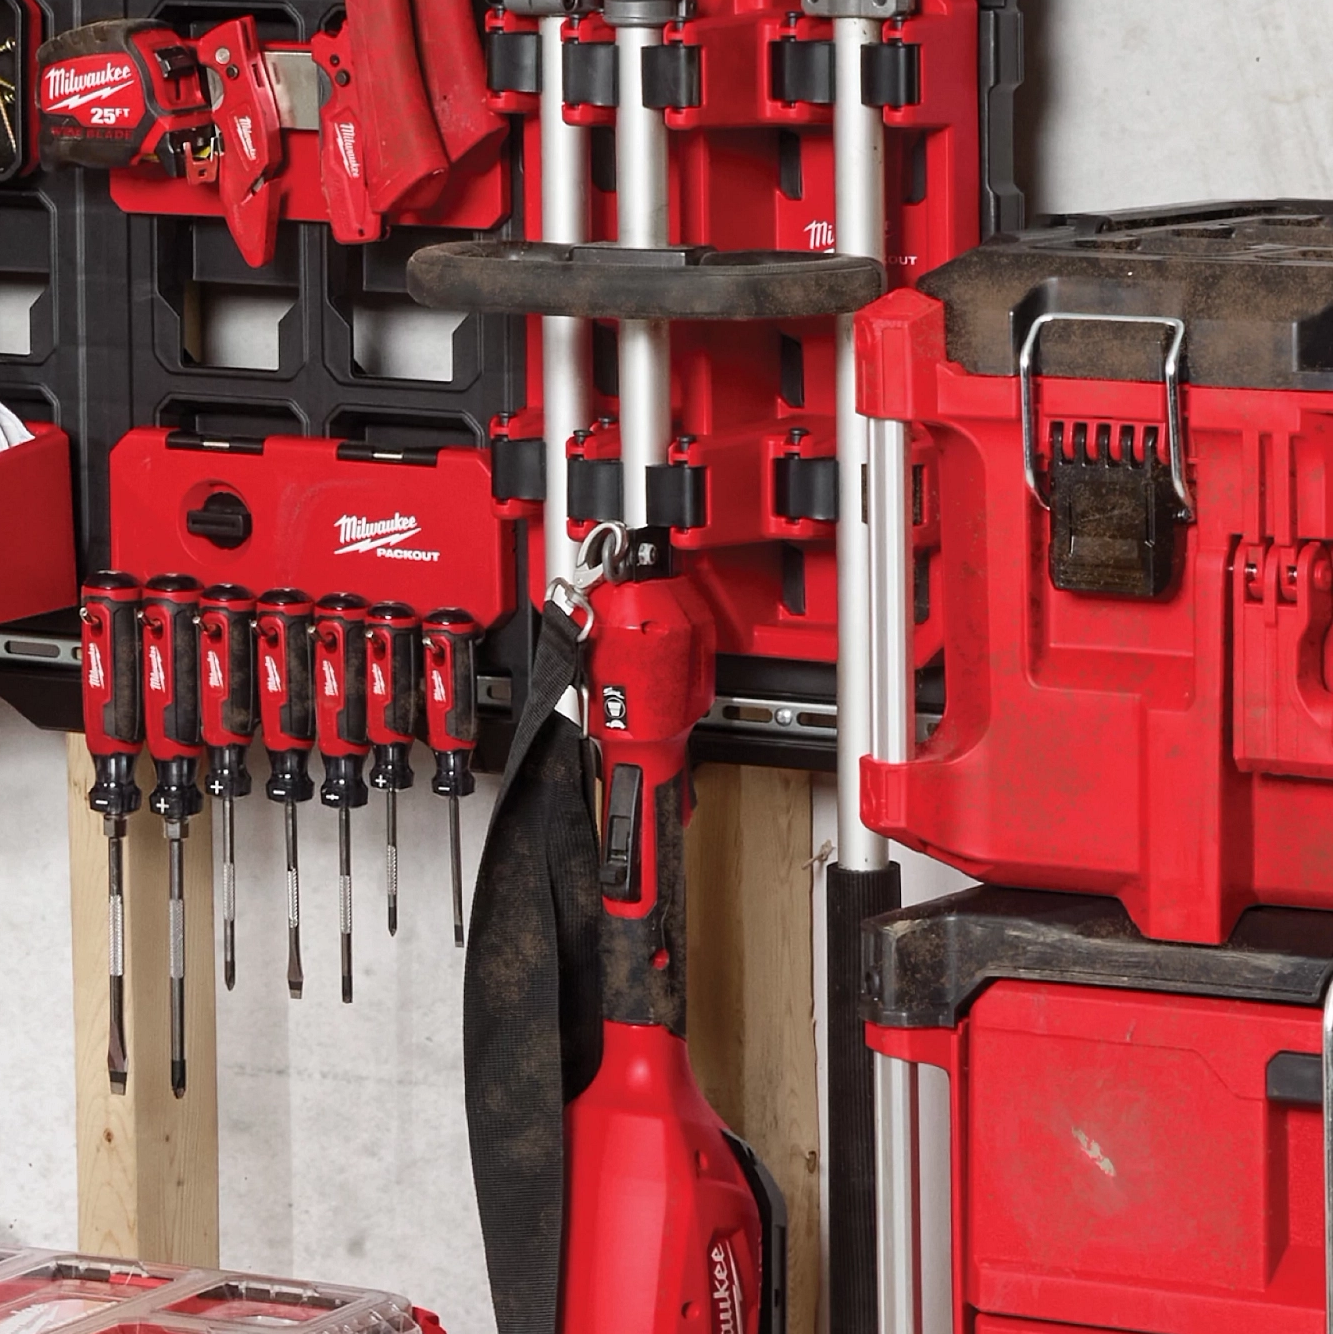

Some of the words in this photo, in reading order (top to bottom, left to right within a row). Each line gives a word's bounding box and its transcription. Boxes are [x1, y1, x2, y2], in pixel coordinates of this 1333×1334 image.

[45, 62, 132, 100] Milwaukee
[333, 512, 418, 545] Milwaukee
[376, 547, 441, 562] PACKOUT
